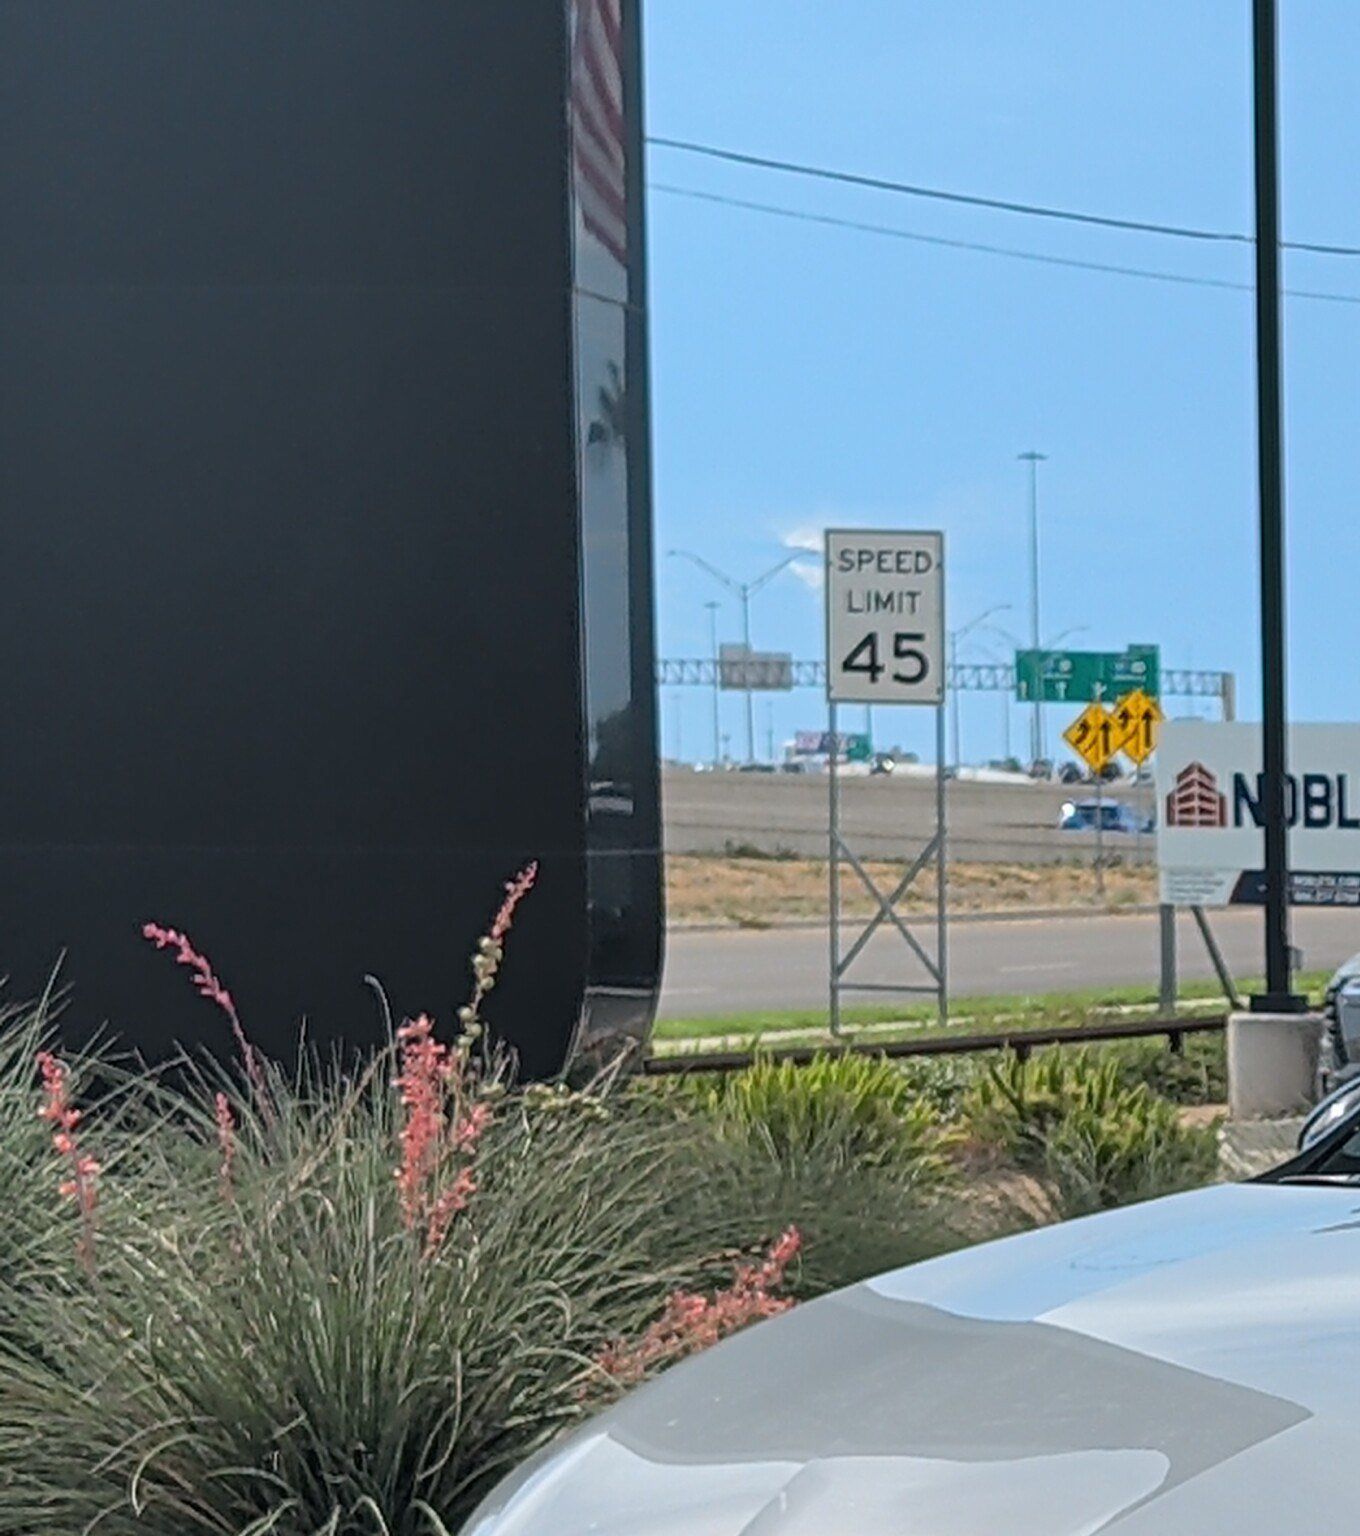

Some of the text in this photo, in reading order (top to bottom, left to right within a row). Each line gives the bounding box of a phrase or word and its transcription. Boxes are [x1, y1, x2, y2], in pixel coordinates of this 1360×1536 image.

[838, 548, 932, 575] SPEED
[847, 589, 922, 615] LIMIT
[842, 631, 930, 685] 45
